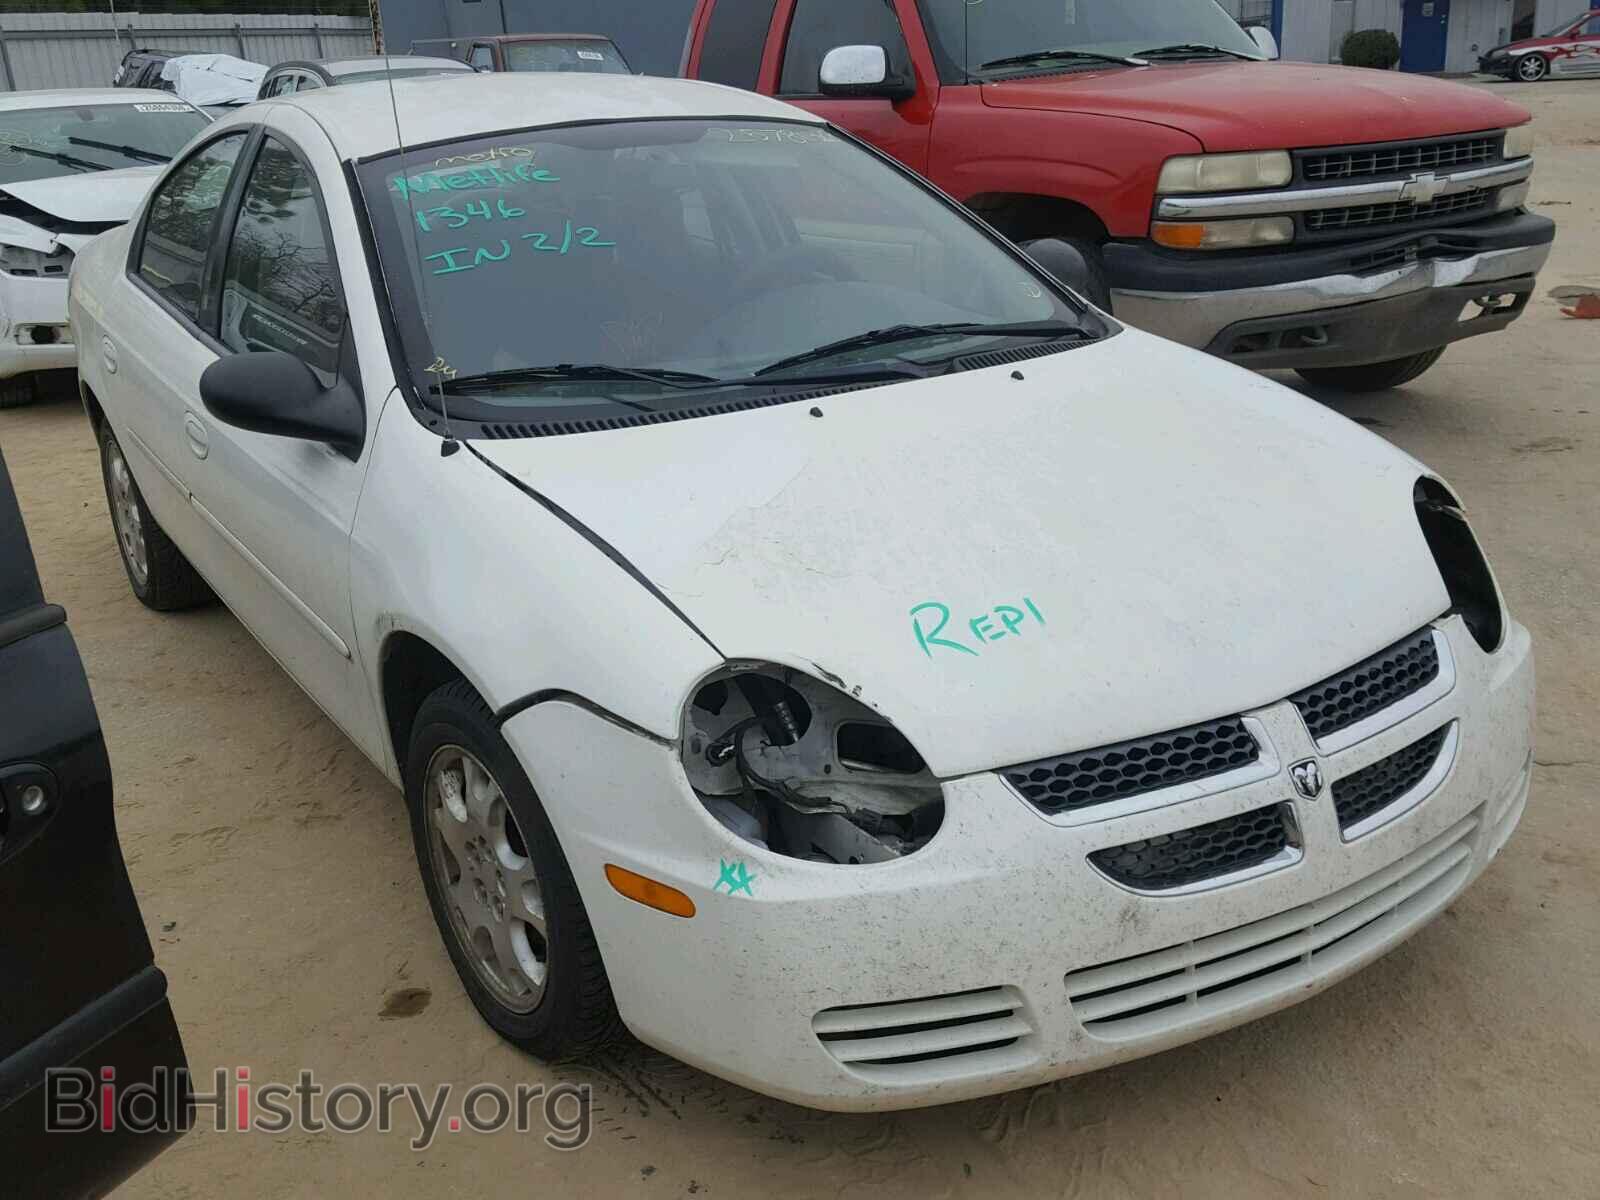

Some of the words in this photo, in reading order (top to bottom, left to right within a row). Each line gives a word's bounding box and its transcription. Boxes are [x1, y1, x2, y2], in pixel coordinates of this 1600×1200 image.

[416, 199, 526, 232] 1346
[424, 238, 511, 275] IN
[521, 219, 617, 255] 2/2
